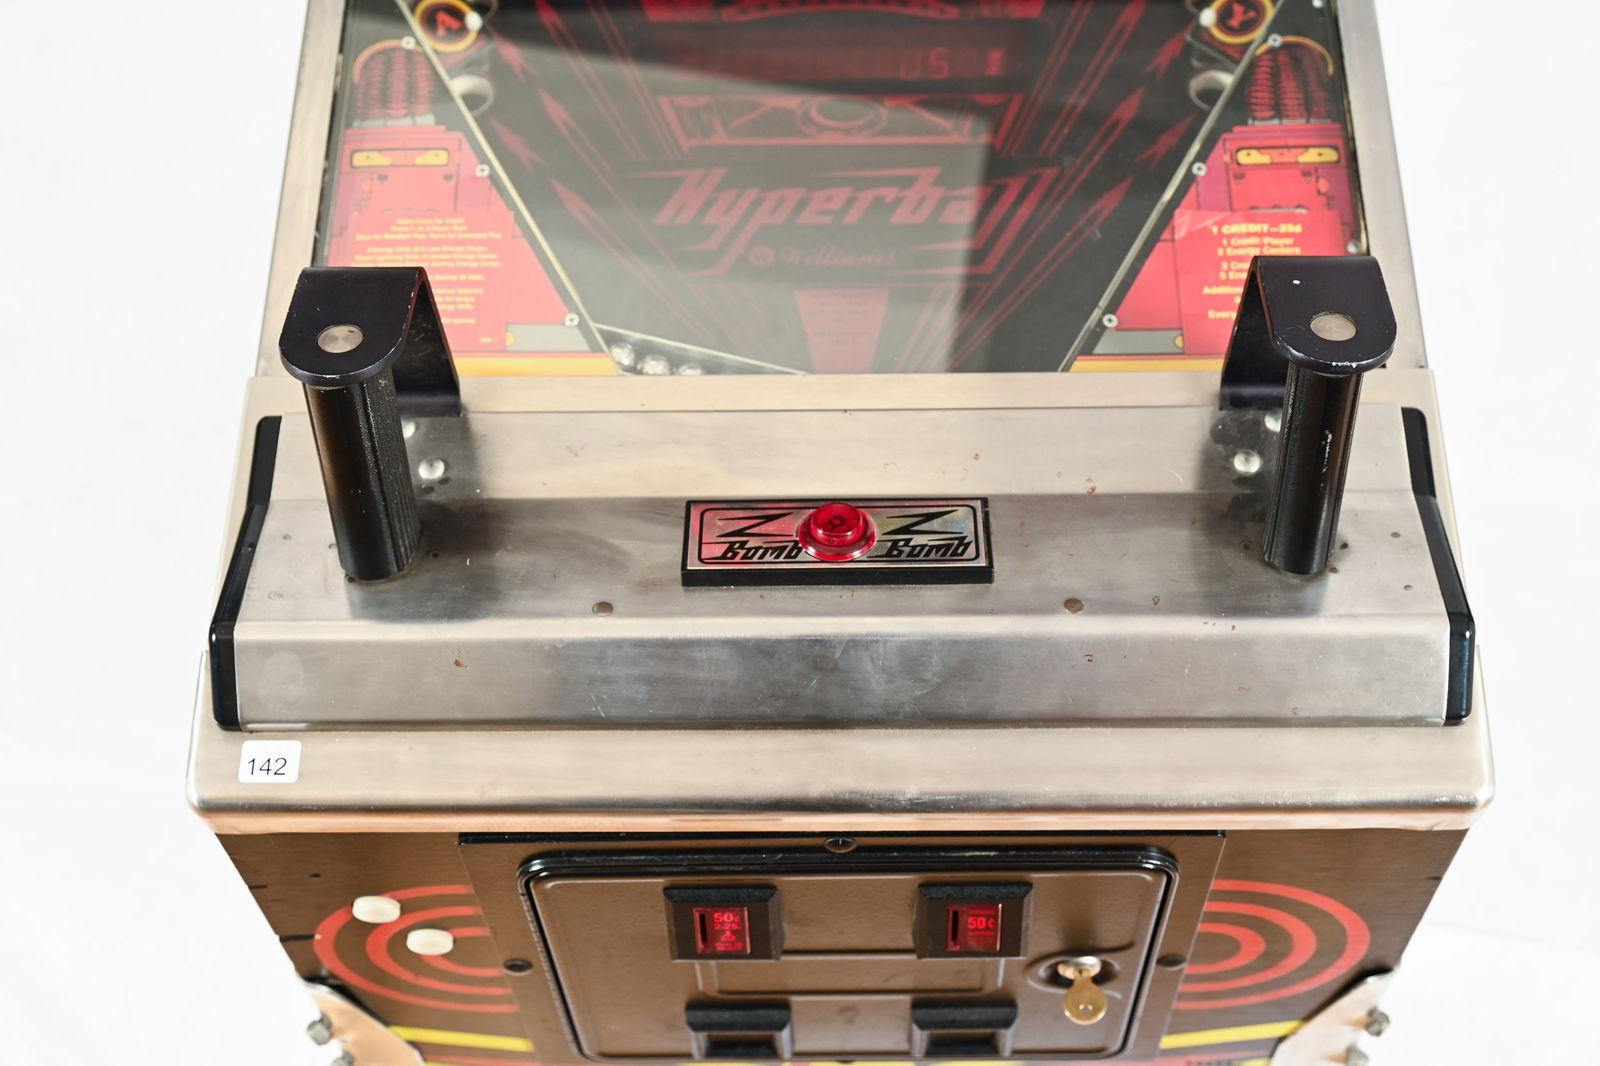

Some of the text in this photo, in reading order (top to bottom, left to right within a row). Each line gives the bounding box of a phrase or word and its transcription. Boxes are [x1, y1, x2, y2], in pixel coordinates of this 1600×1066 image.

[624, 165, 1061, 276] Hyperball
[717, 511, 793, 538] Z
[881, 509, 964, 536] Z
[701, 539, 804, 561] Bomb
[867, 536, 973, 559] Bomb
[247, 757, 288, 776] 142
